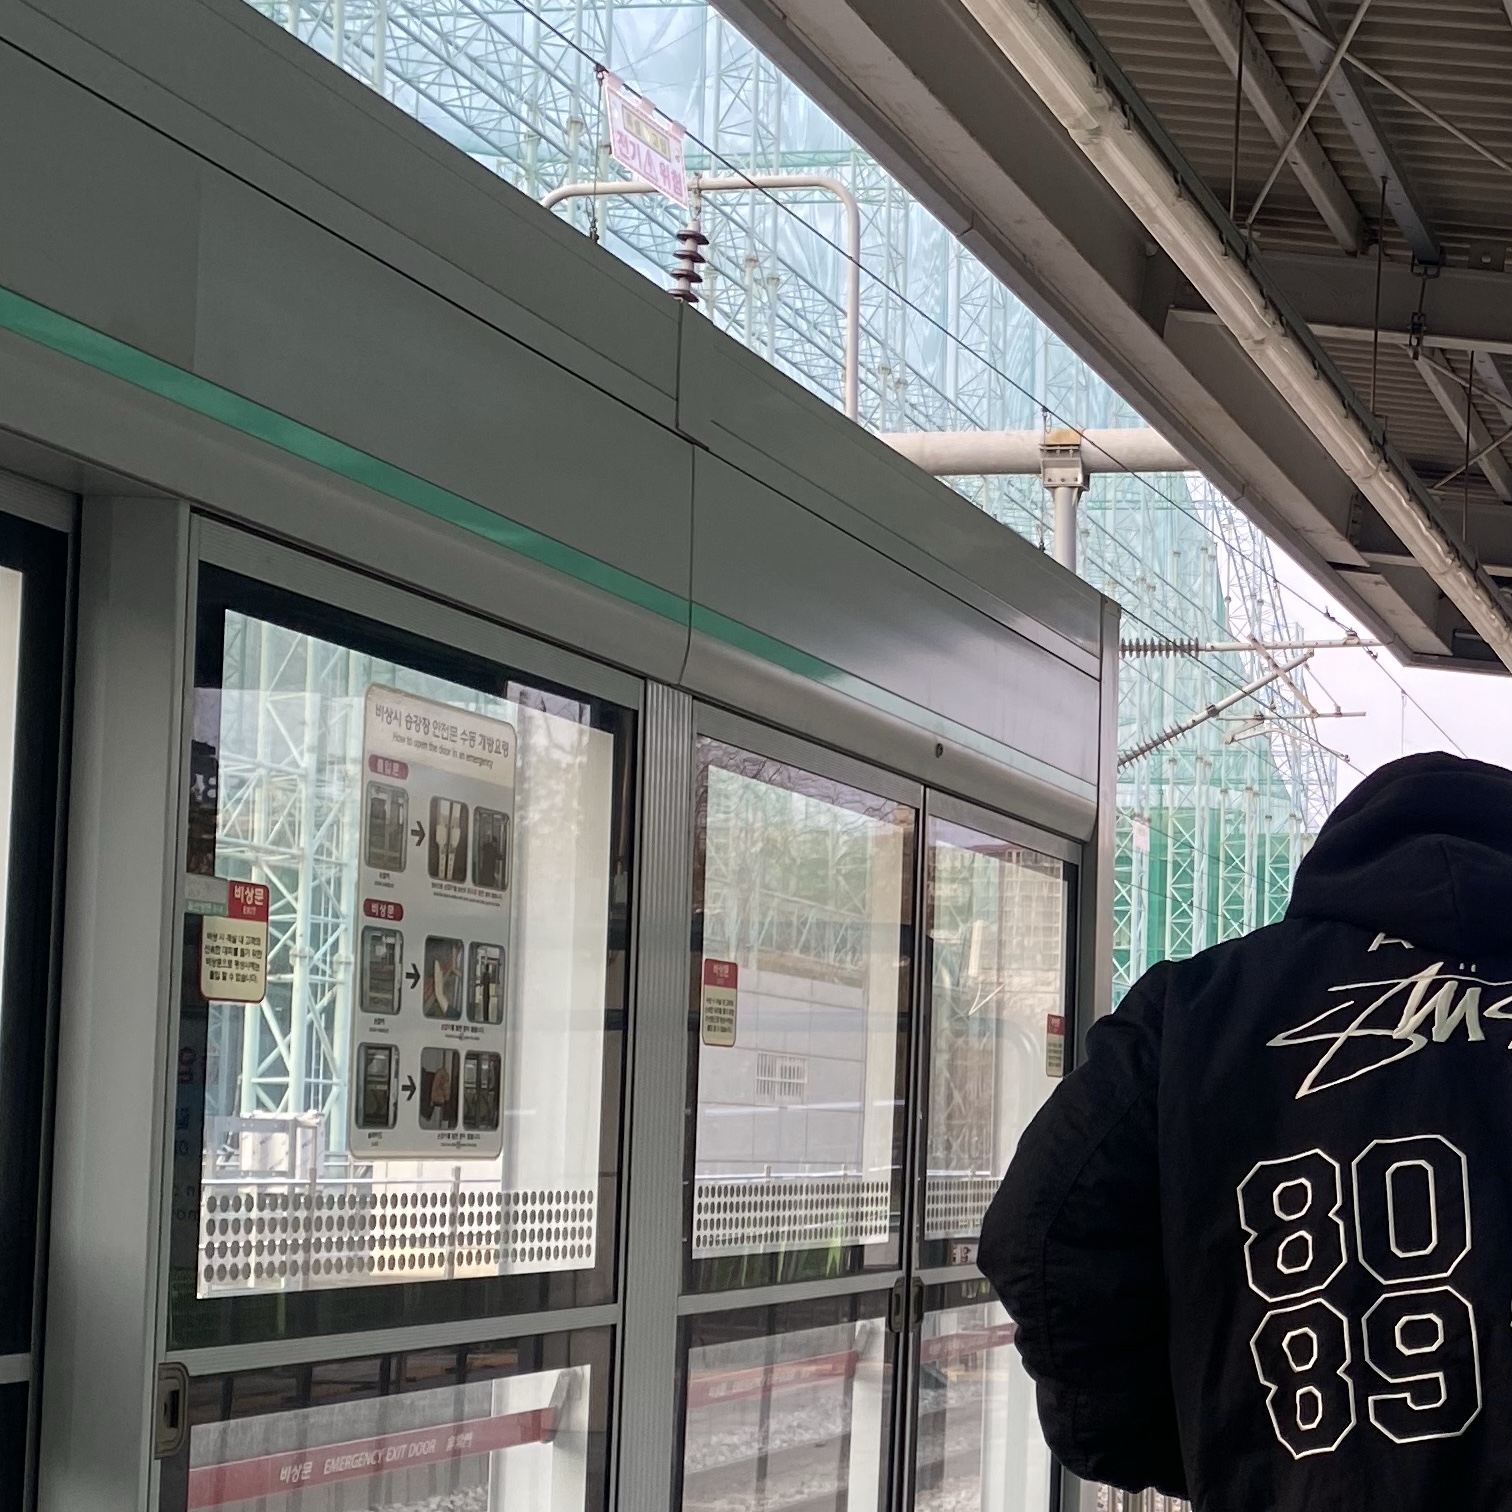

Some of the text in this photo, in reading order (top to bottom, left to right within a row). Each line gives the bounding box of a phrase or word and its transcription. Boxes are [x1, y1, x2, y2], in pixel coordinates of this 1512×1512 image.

[375, 703, 402, 728] 비상시
[234, 885, 264, 906] 비상문
[371, 902, 394, 919] 비상문
[1237, 1134, 1471, 1302] 80
[1250, 1285, 1482, 1459] 89
[279, 1461, 312, 1483] 비상문
[324, 1448, 384, 1475] EMERGENCY
[385, 1444, 407, 1462] EXIT
[408, 1439, 436, 1457] DOOR
